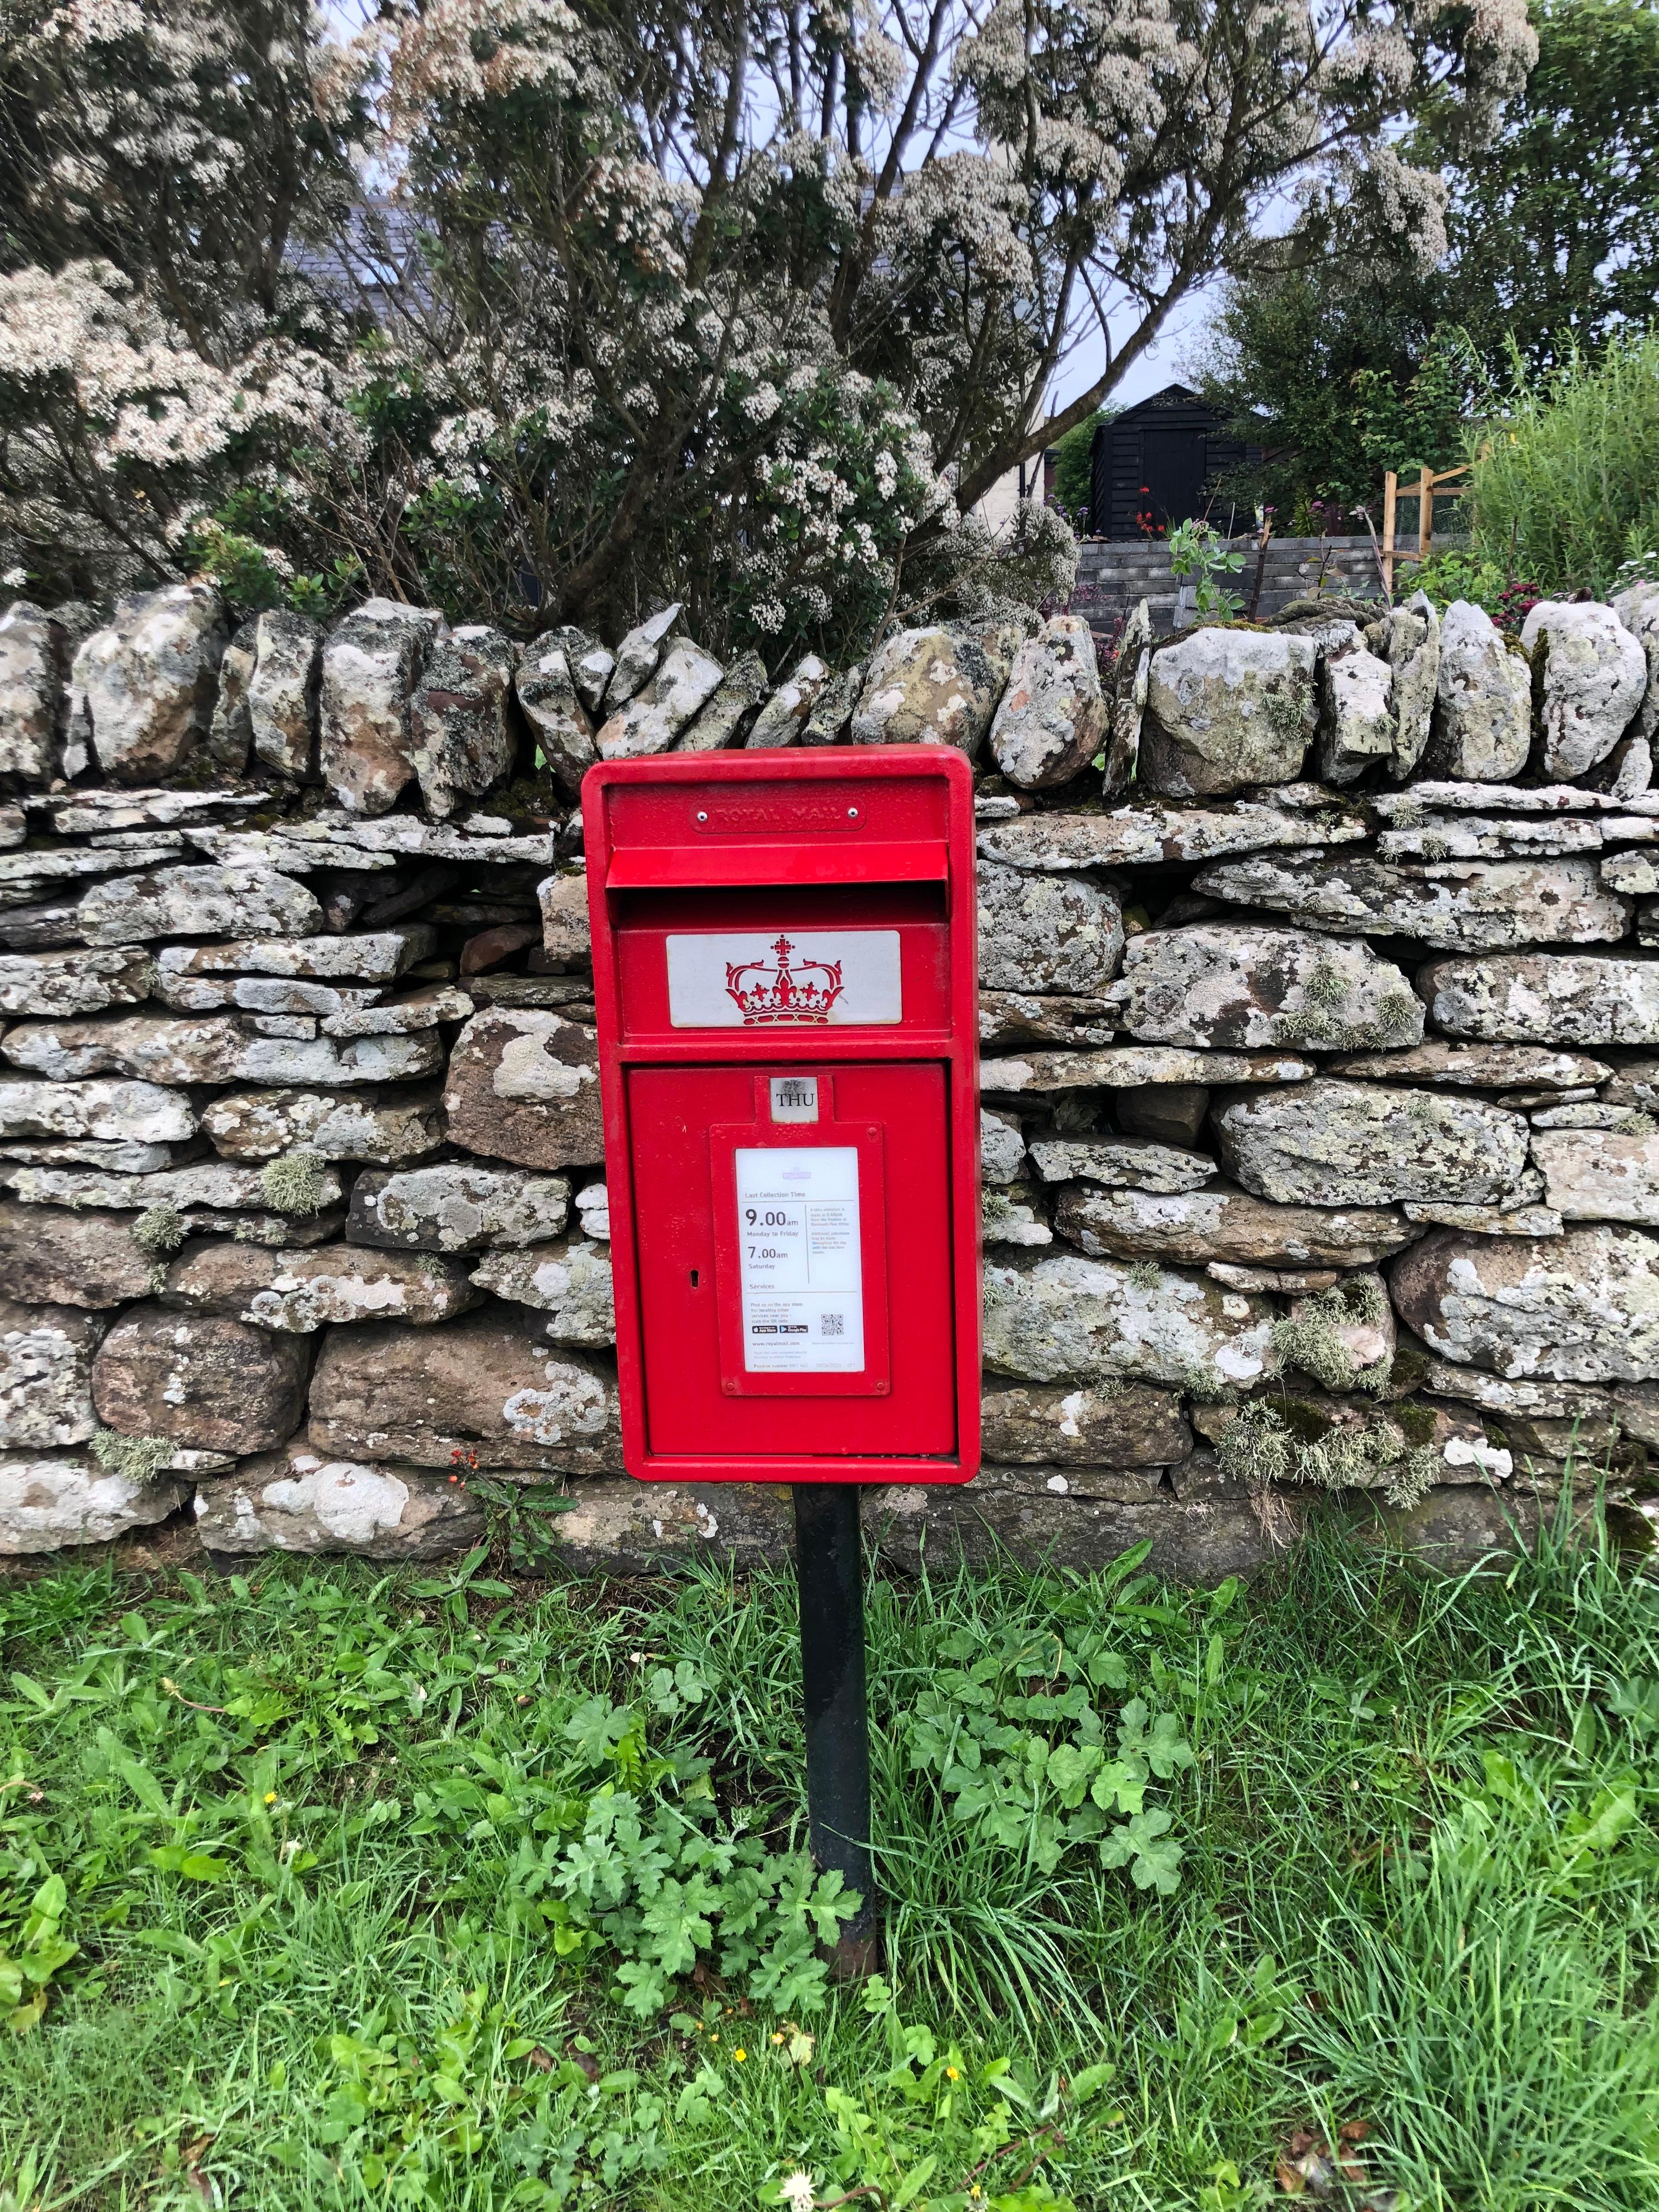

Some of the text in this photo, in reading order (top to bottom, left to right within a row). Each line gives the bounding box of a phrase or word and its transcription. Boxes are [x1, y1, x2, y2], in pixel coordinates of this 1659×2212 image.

[713, 806, 842, 822] ROYAL MAIL
[776, 1093, 815, 1107] THU
[746, 1209, 799, 1226] 9.00am
[748, 1246, 788, 1259] 7.00am
